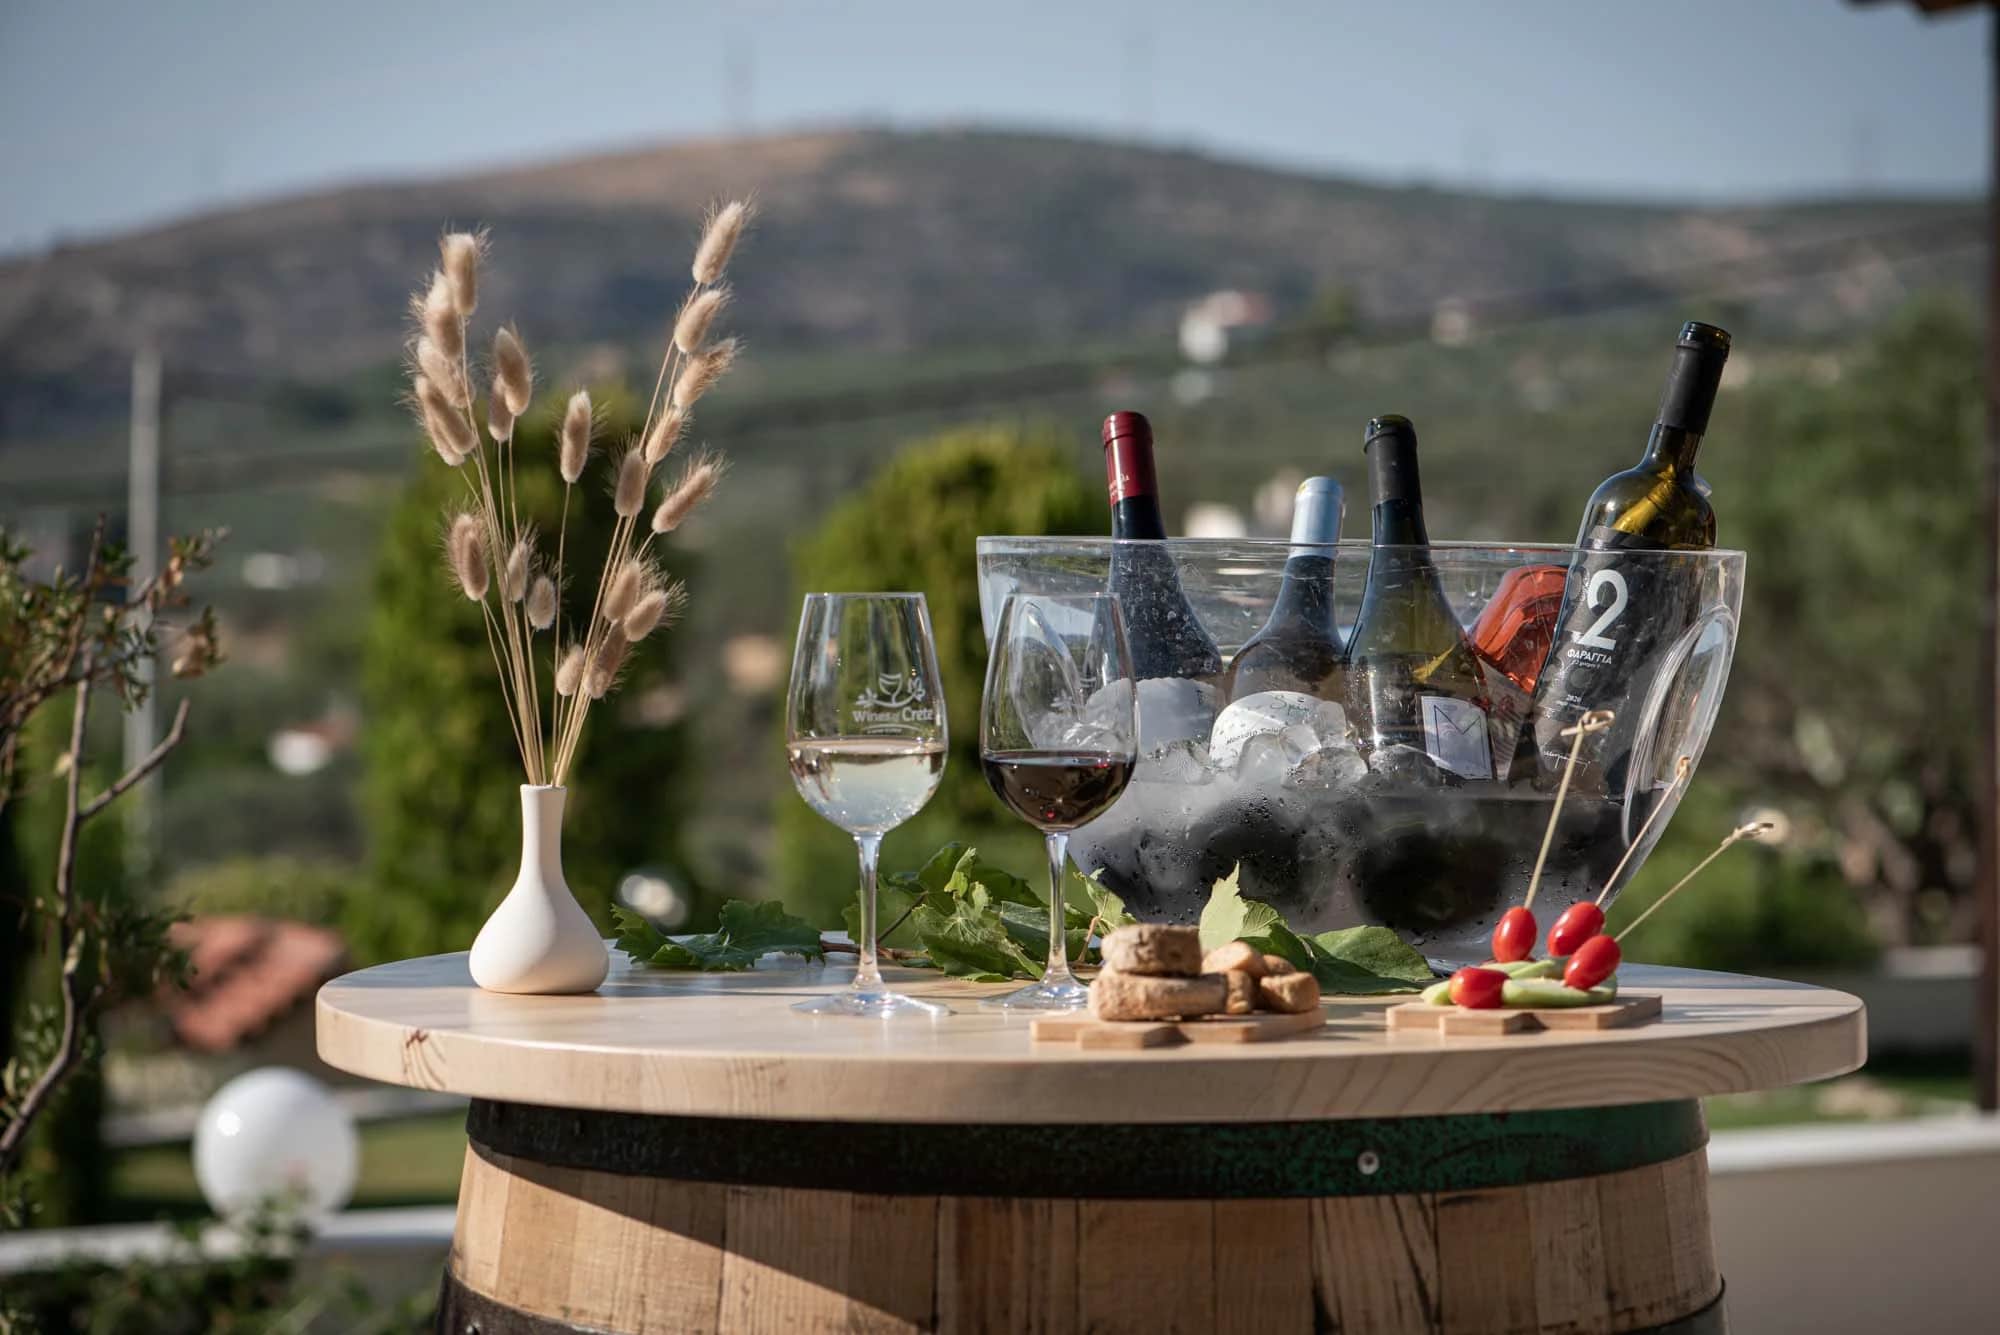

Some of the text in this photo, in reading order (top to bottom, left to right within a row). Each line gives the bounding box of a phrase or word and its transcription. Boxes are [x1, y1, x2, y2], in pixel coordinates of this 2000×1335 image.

[1578, 569, 1628, 651] 2
[1567, 648, 1612, 665] ΦΑΡΑΓΓΙΑ
[852, 710, 890, 722] Wines
[902, 706, 934, 721] Crete
